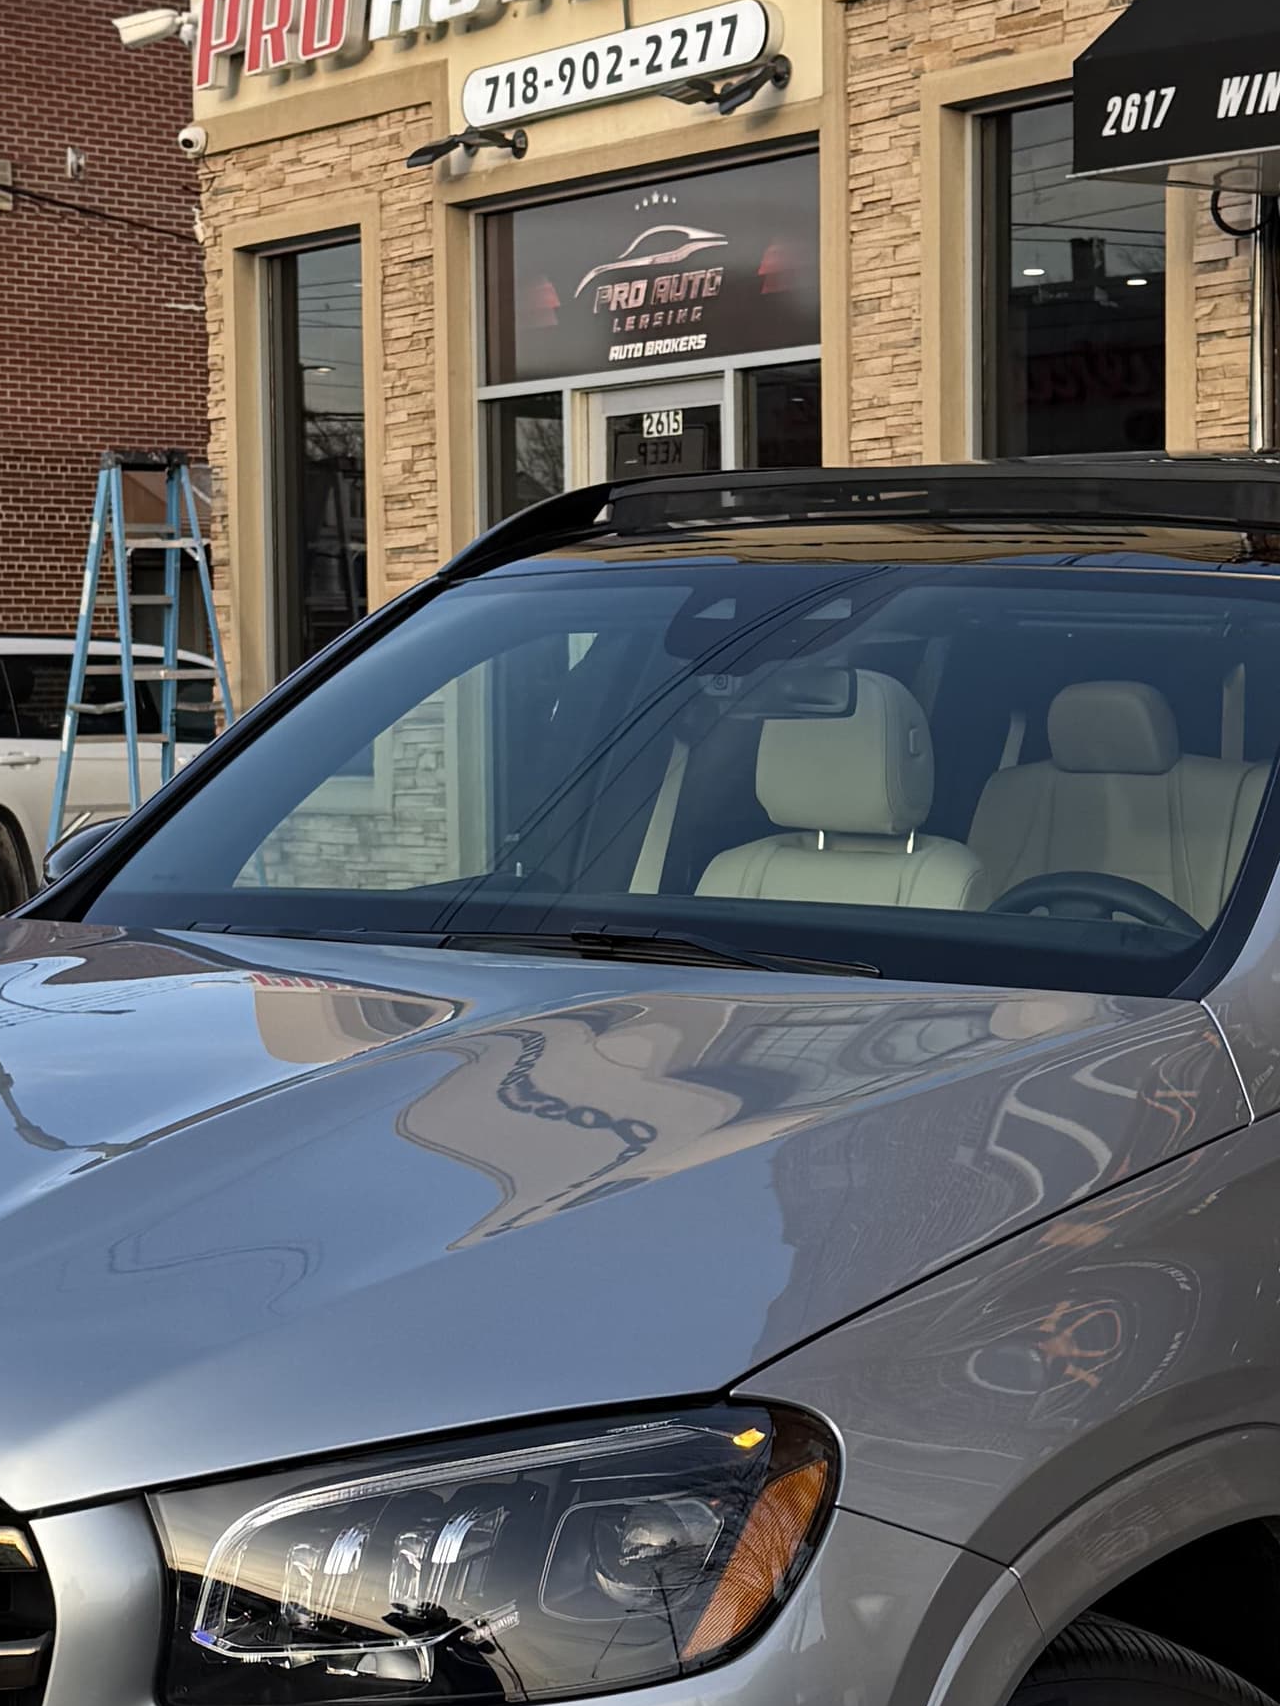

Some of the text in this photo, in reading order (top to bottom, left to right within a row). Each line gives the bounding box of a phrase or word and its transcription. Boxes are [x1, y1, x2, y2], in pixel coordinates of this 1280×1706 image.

[486, 14, 739, 114] 718-902-2277
[1102, 86, 1177, 137] 2617
[593, 267, 724, 314] PRO AUTO
[613, 305, 703, 334] LEASING
[609, 333, 708, 362] AUTO BROKERS
[644, 410, 682, 436] 2615
